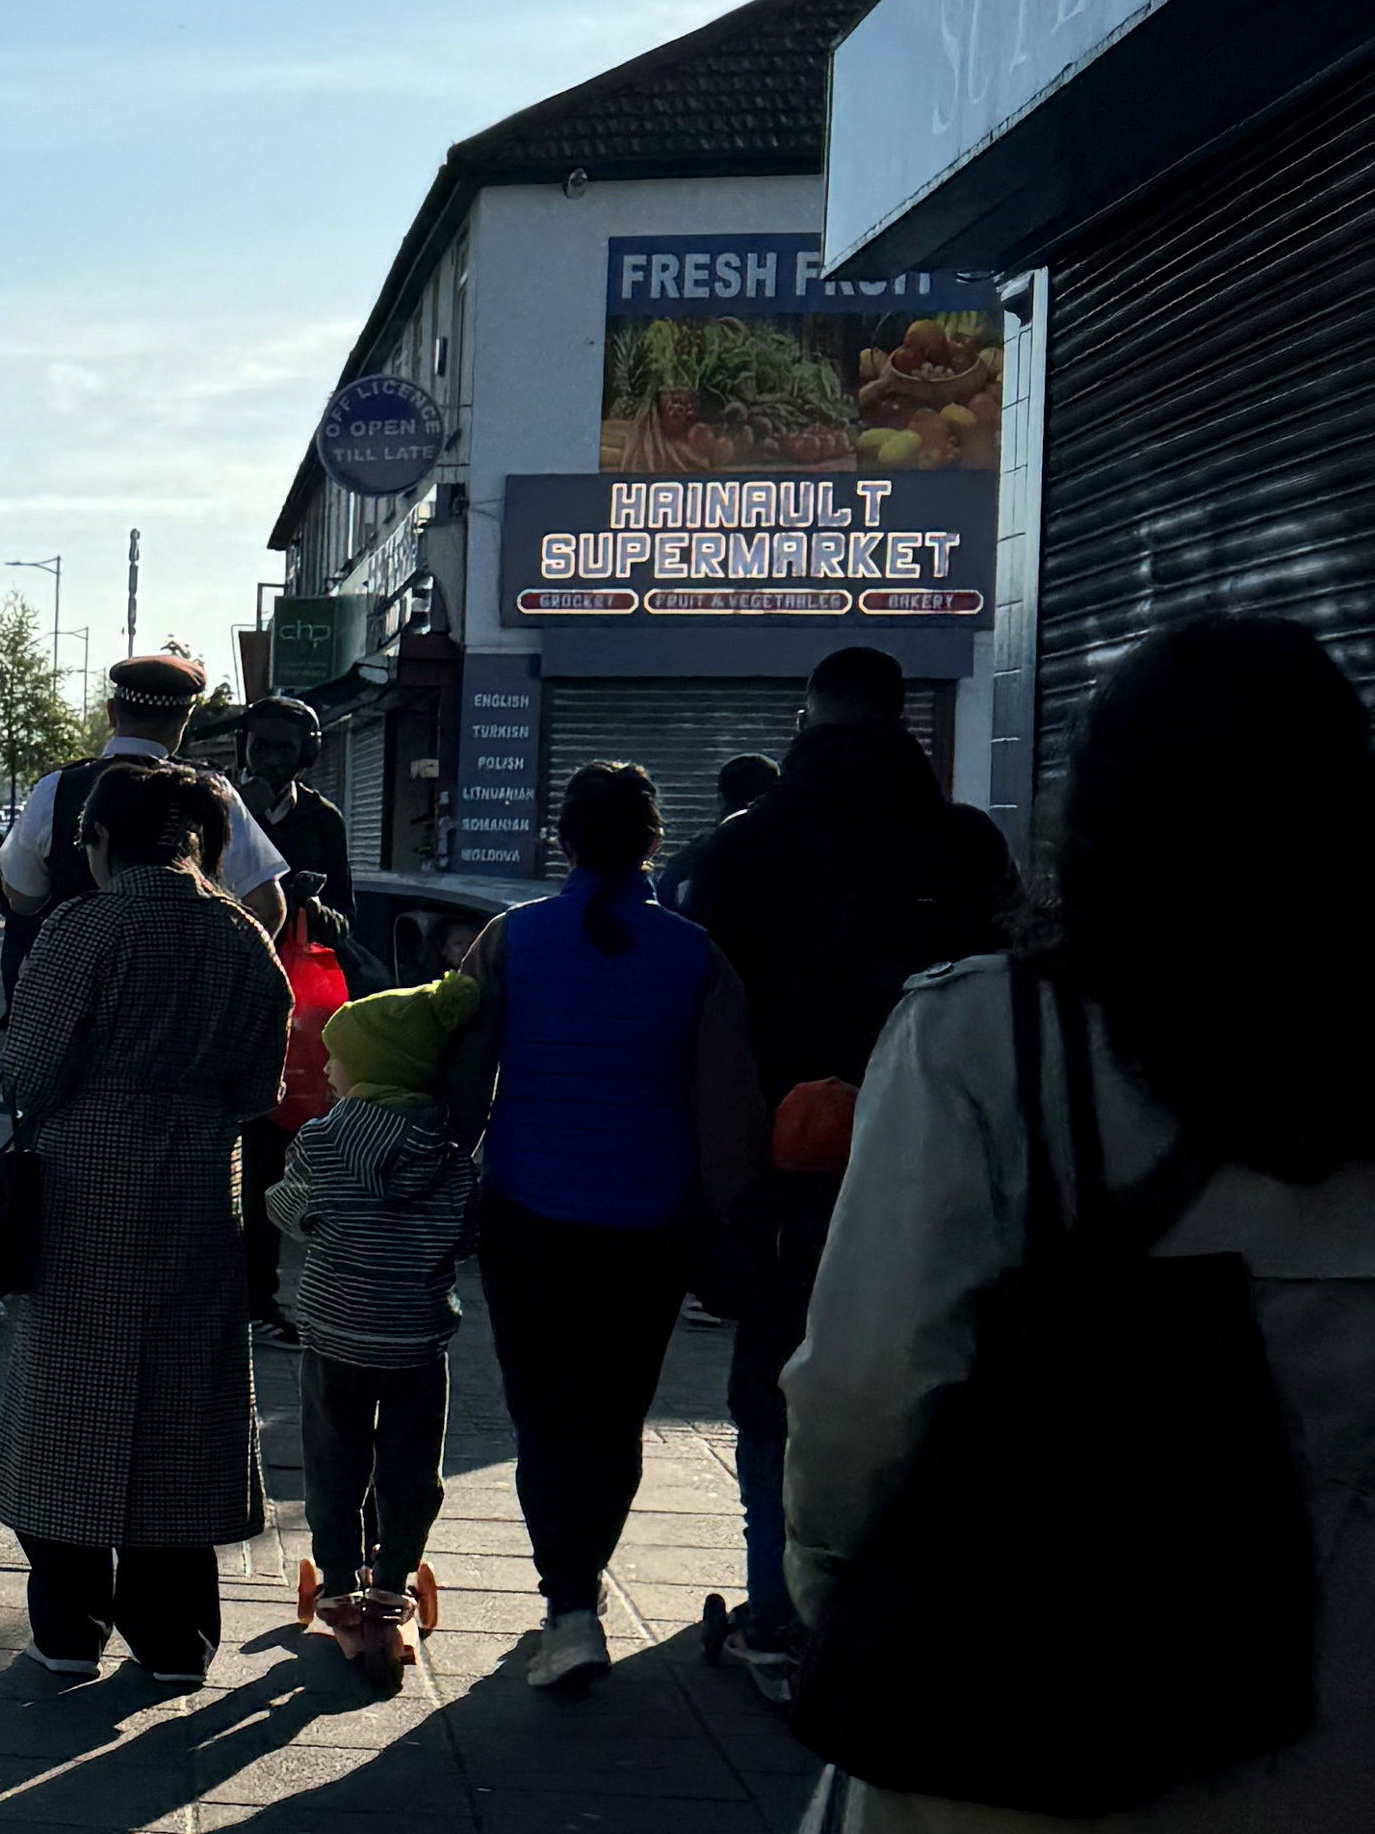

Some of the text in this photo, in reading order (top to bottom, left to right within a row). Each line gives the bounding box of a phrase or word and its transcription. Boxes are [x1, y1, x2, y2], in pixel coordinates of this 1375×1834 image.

[621, 251, 777, 300] FRESH
[326, 379, 441, 437] OFF LICENCE
[350, 419, 416, 437] OPEN
[332, 445, 435, 462] TILL LATE
[610, 480, 892, 530] HAINAULT
[541, 531, 961, 579] SUPERMARKET
[539, 594, 615, 609] GROCERY
[655, 594, 703, 609] FRUIT
[728, 594, 841, 610] VEGETABLES
[888, 594, 955, 609] BAKERY
[474, 693, 530, 708] ENGLISH
[472, 725, 530, 739] TURKISH
[477, 755, 525, 770] POLISH
[462, 786, 535, 801] LITHUANIAN
[461, 848, 521, 862] MOLDOVA
